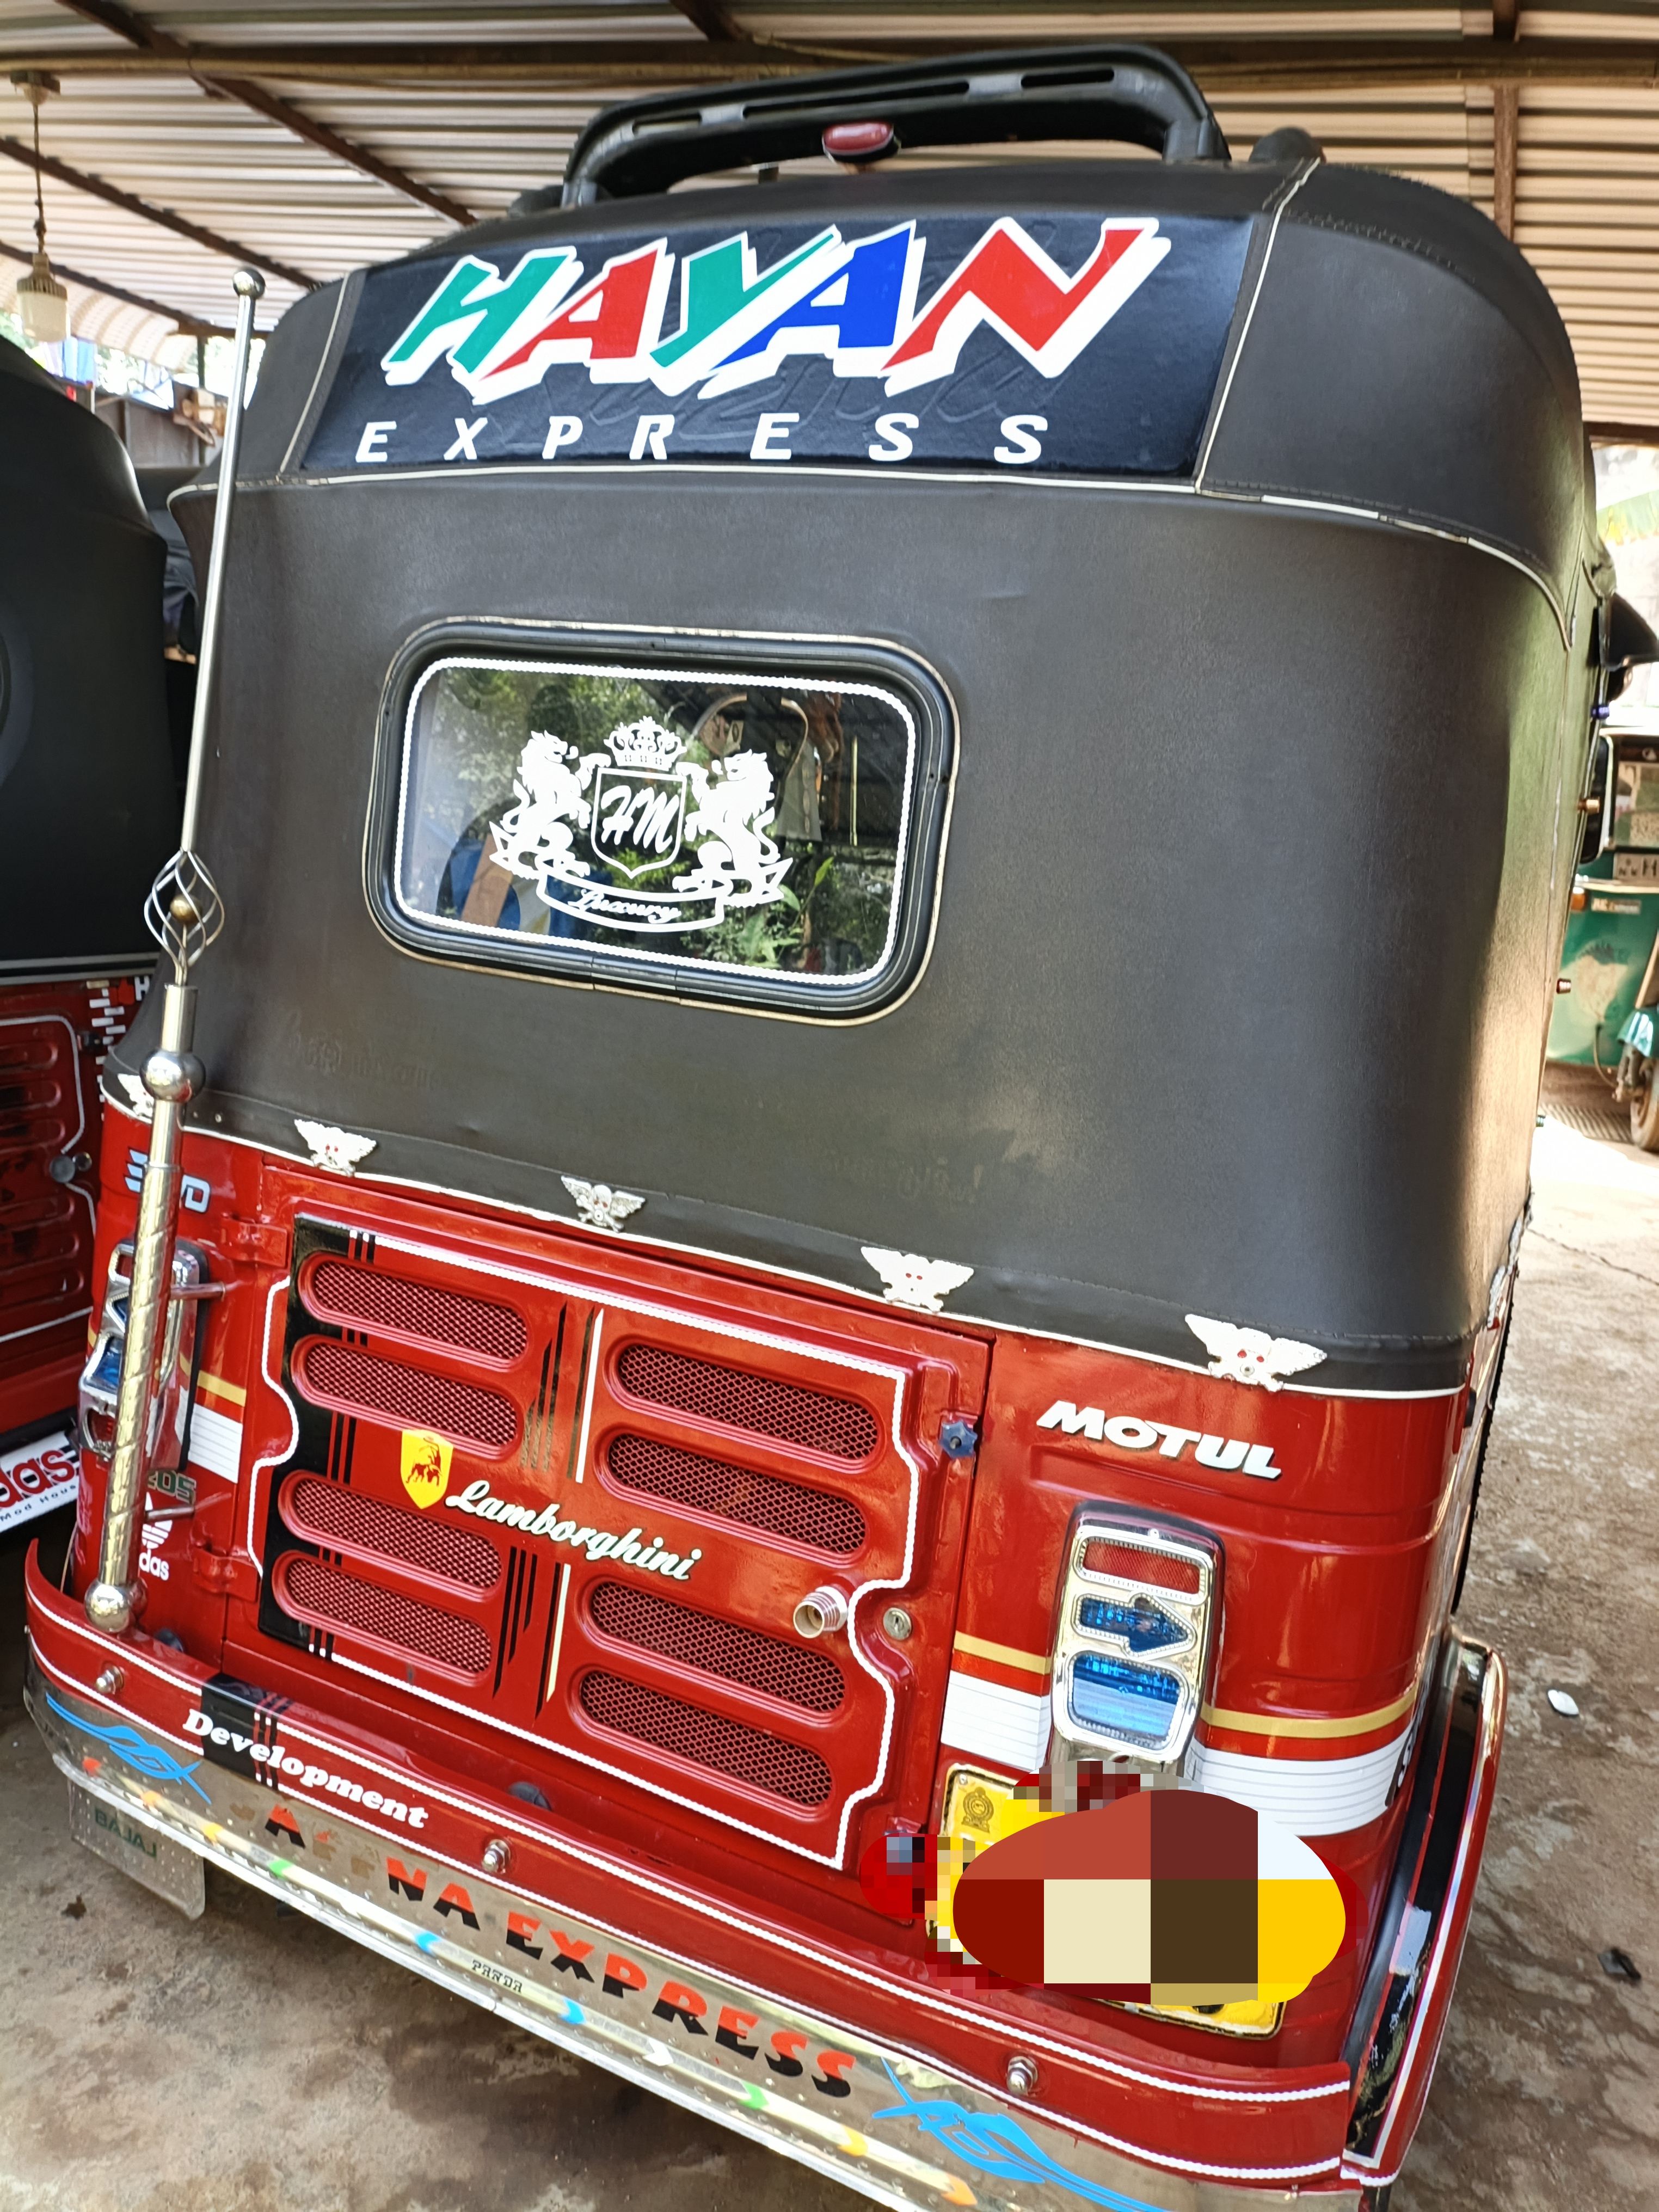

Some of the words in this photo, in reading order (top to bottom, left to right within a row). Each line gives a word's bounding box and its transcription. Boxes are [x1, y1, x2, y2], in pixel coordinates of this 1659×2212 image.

[381, 217, 1171, 405] HAYAN
[355, 412, 1048, 464] EXPRESS
[1036, 1400, 1281, 1479] MOTUL
[445, 1480, 702, 1580] Lamborghini
[183, 1709, 429, 1829] Development
[95, 1807, 157, 1859] BAJAJ
[472, 1959, 523, 1993] PANDA
[506, 1911, 857, 2098] EXPRESS
